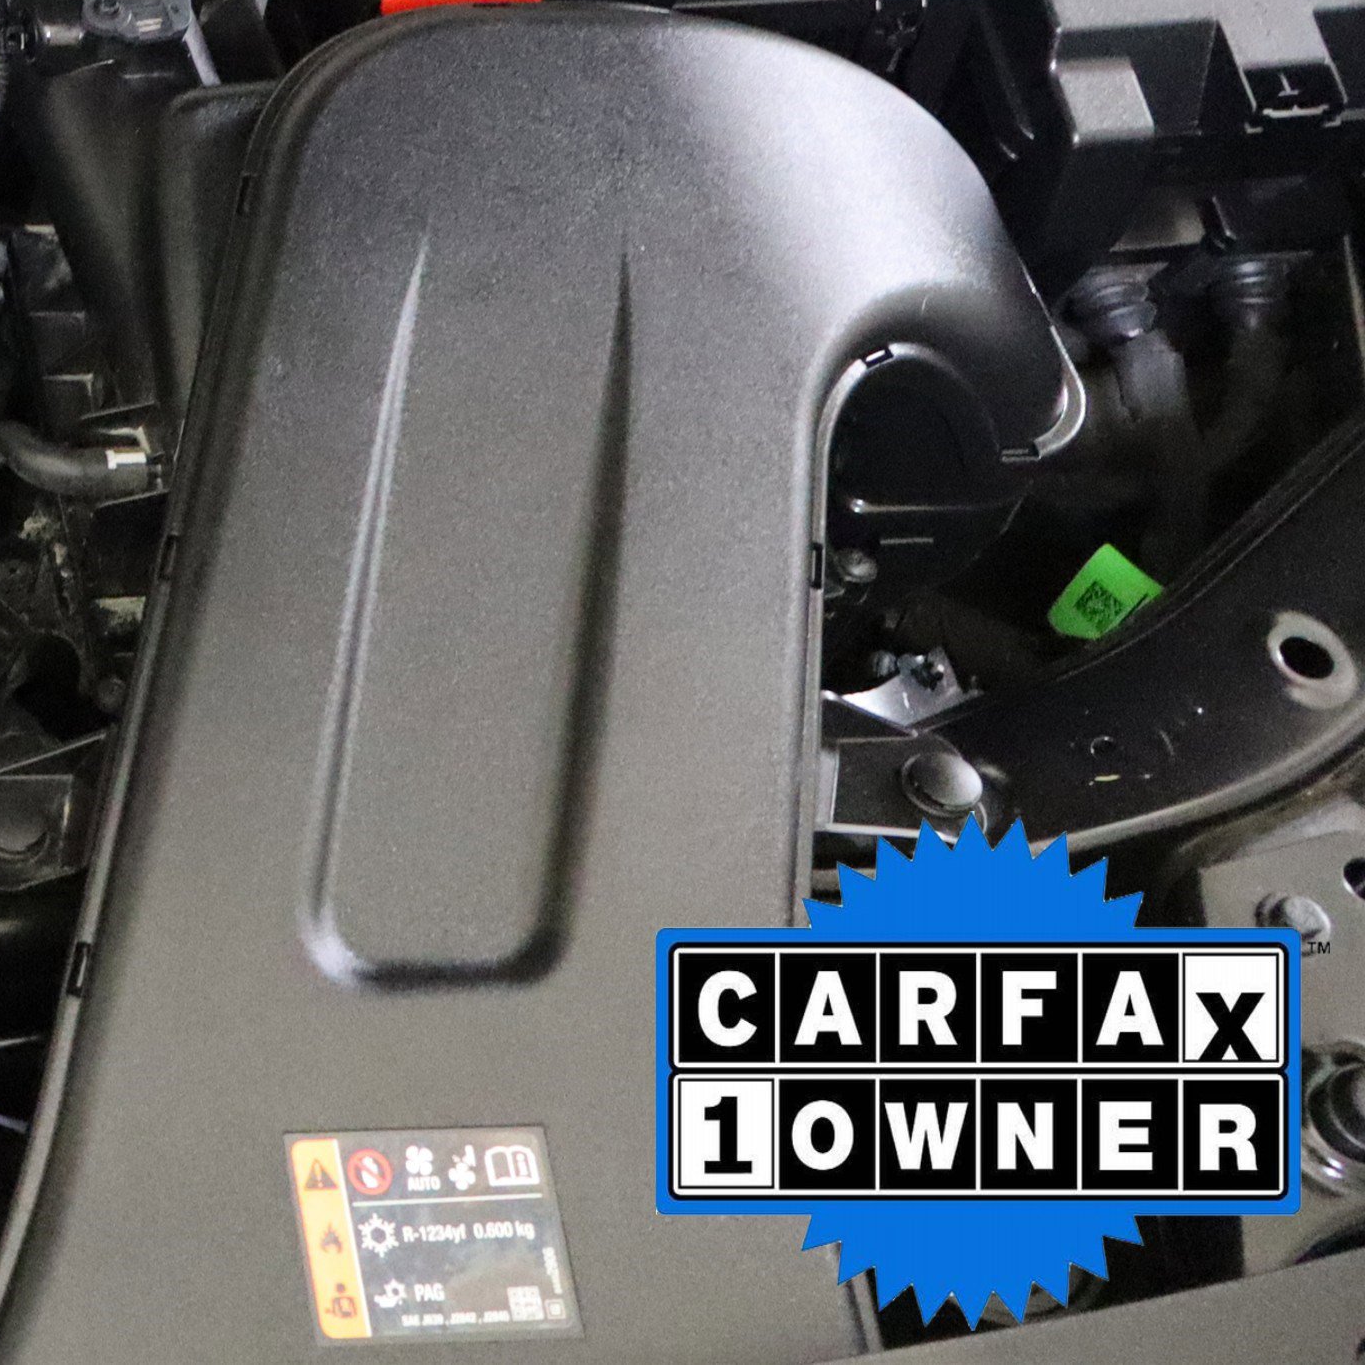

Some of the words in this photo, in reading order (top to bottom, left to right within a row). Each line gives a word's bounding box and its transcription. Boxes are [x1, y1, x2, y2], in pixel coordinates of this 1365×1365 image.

[407, 1175, 441, 1191] AUTO
[403, 1223, 466, 1244] R-1234yf
[473, 1221, 514, 1239] 0.600
[515, 1220, 536, 1241] kg
[414, 1282, 445, 1302] PAG
